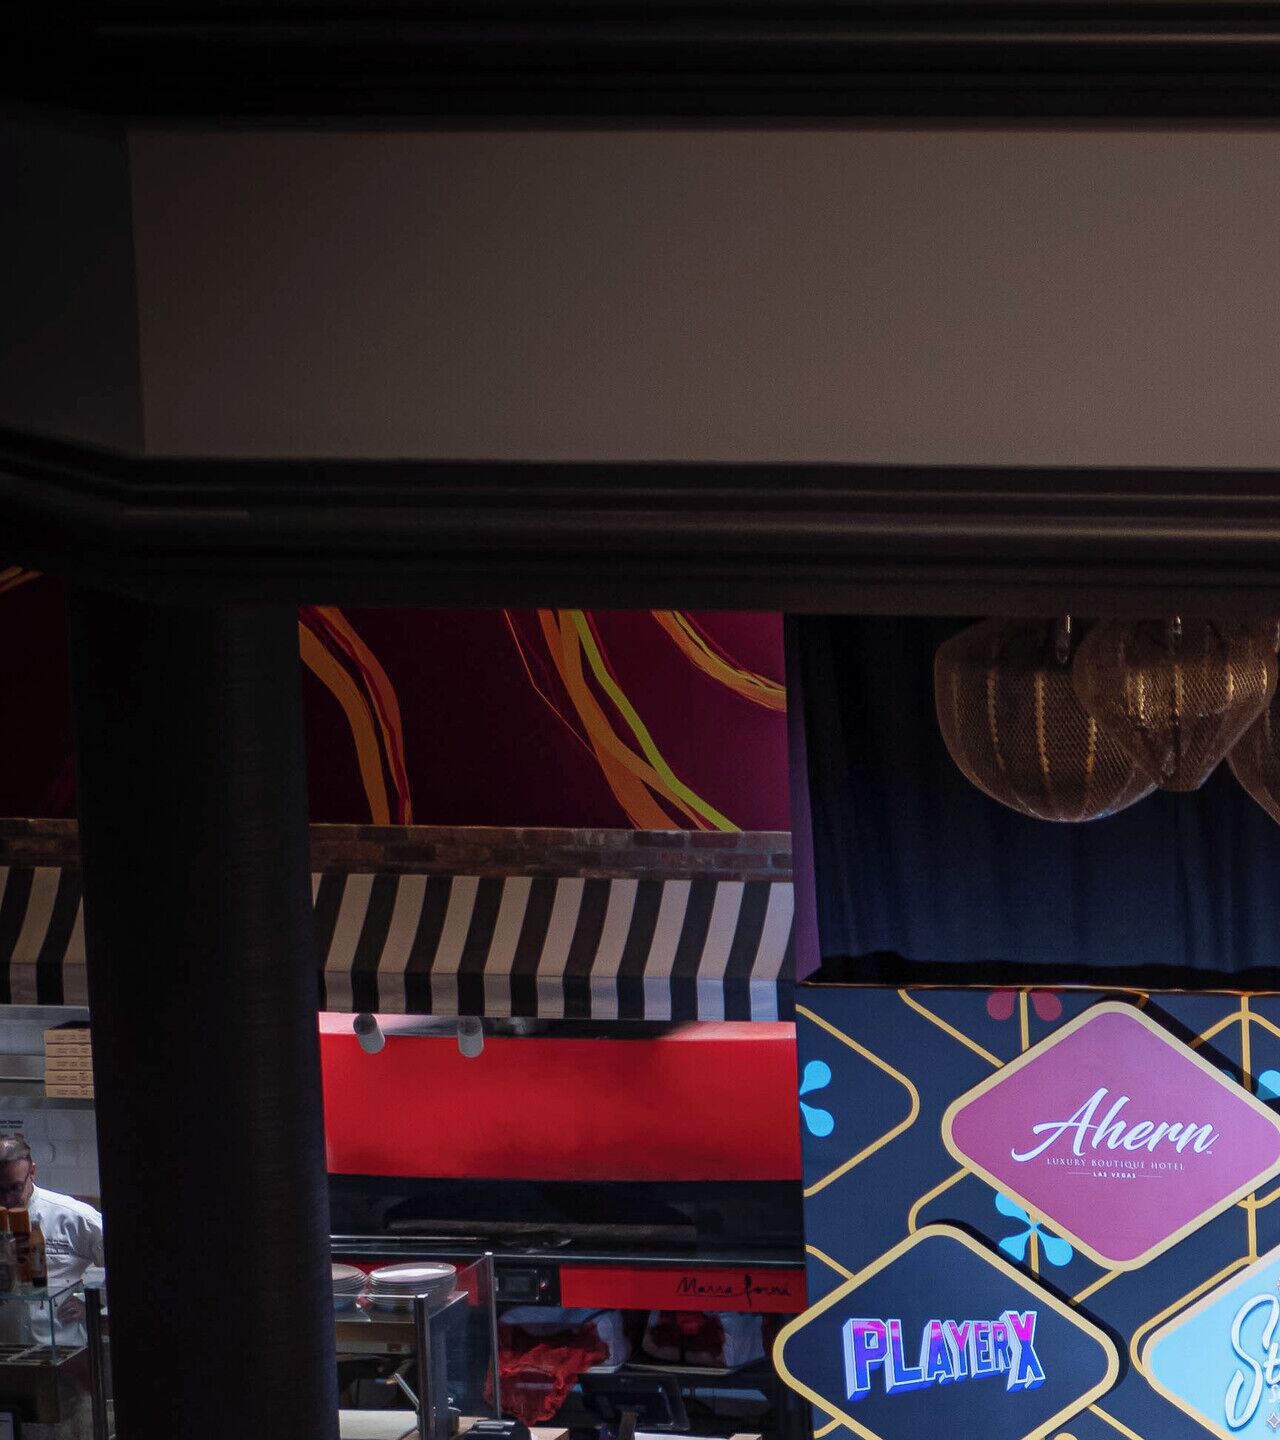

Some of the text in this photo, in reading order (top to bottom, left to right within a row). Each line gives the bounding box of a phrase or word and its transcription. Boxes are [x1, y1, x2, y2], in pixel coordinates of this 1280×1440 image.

[1011, 1087, 1220, 1162] Ahern
[1047, 1157, 1184, 1171] LUXURY BOUTIQUE HOTEL
[842, 1310, 1046, 1402] PLAYERX
